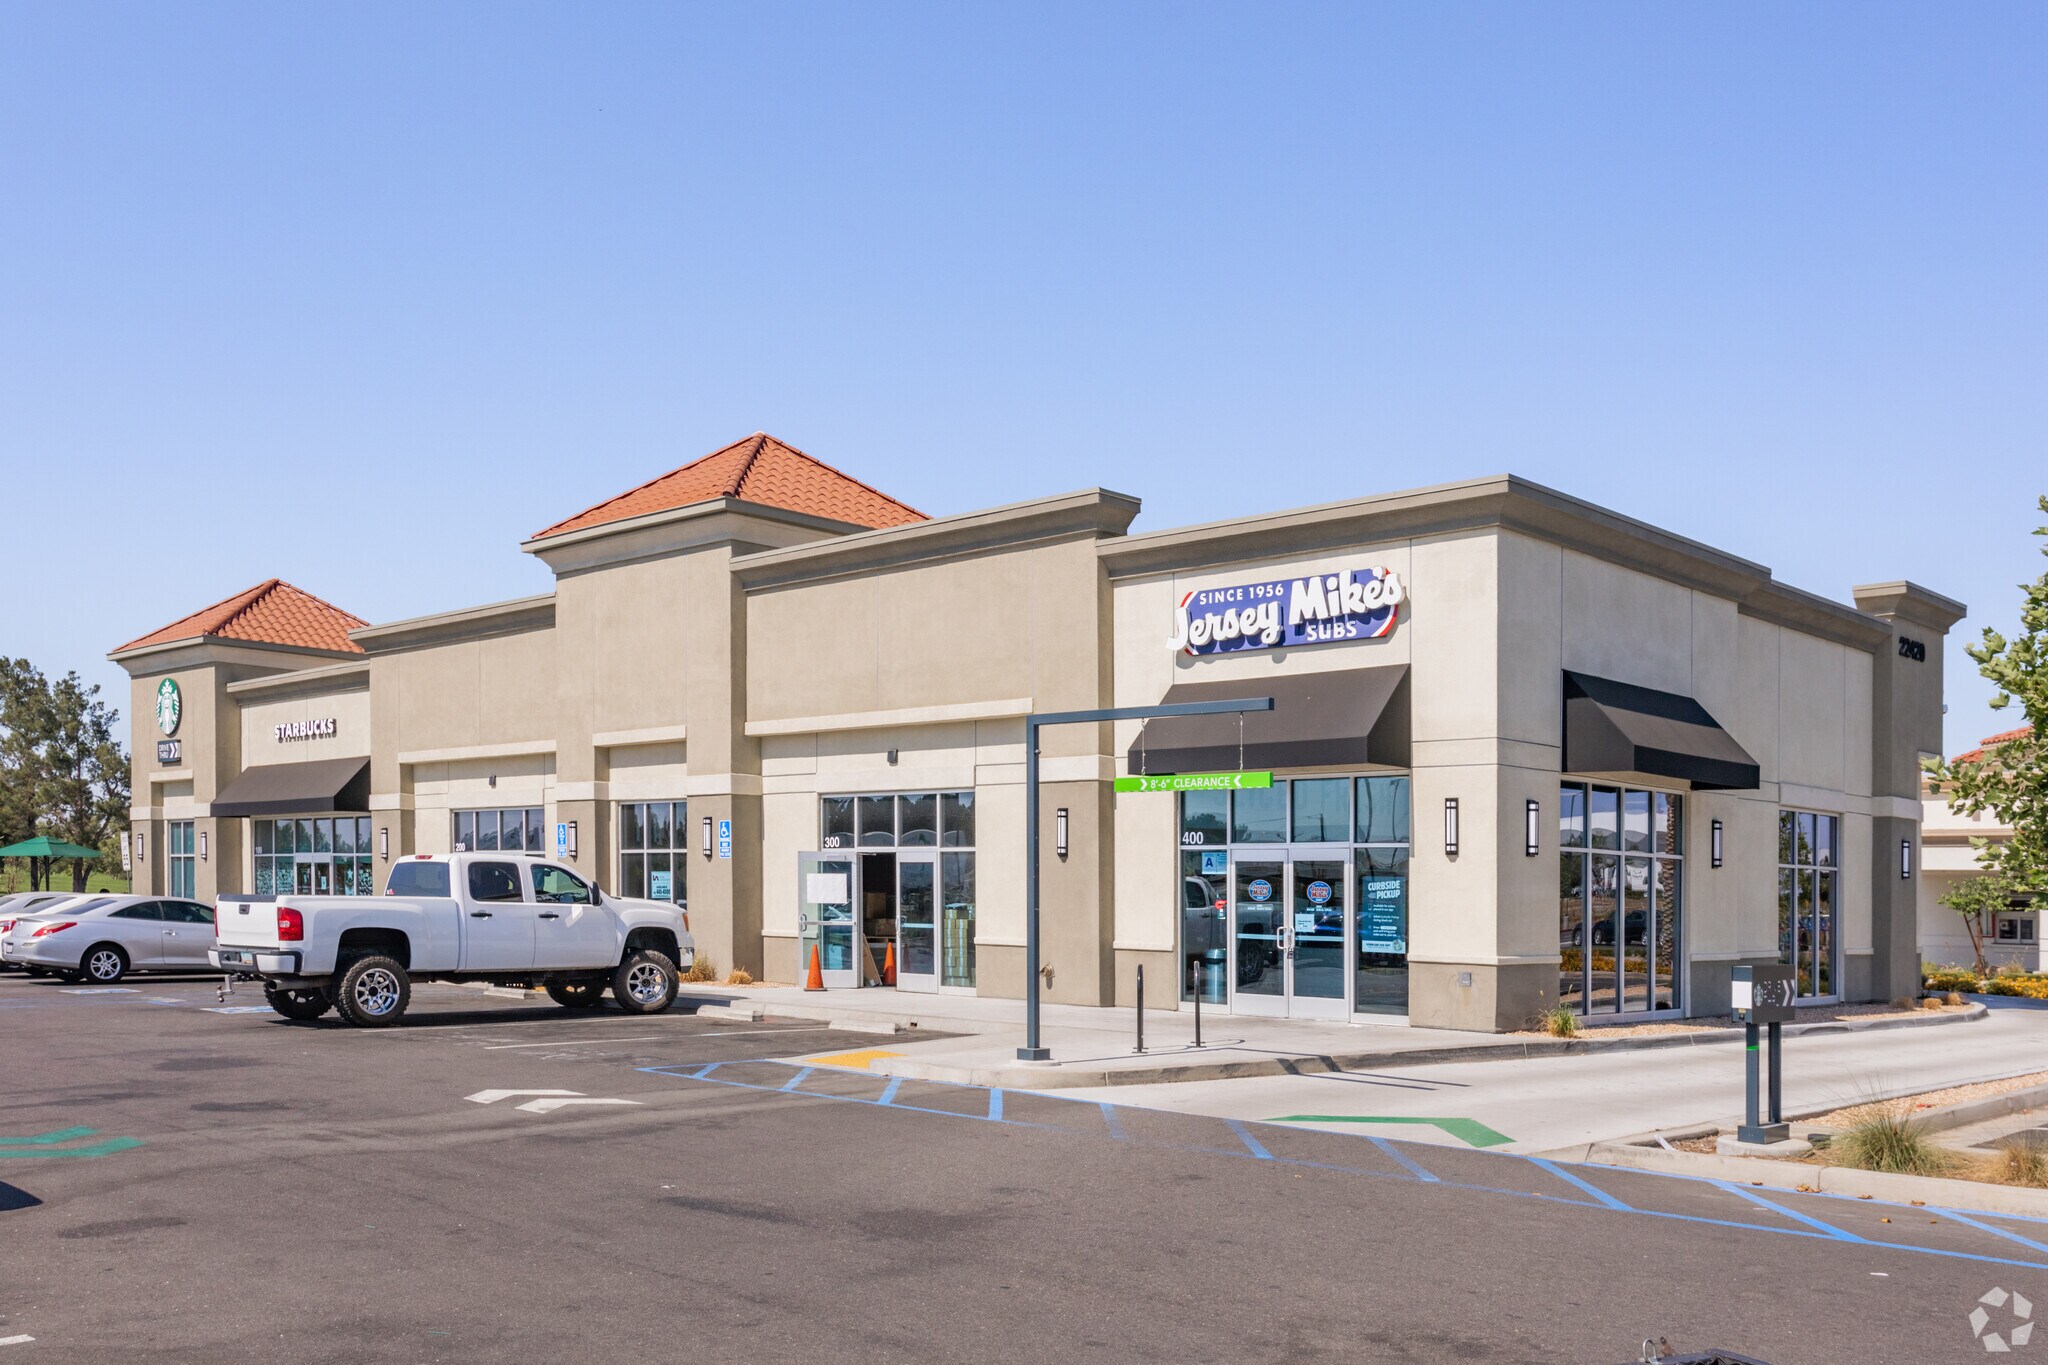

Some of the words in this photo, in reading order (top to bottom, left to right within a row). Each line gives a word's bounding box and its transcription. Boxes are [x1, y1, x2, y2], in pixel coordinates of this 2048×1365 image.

[1199, 588, 1243, 605] SINCE
[1249, 583, 1284, 600] 1956
[1164, 600, 1284, 650] Jersey
[1288, 565, 1405, 626] Mike's
[1306, 620, 1357, 641] SUBS
[275, 718, 334, 740] STARBUCKS
[1174, 776, 1231, 788] CLEARANCE
[824, 836, 840, 848] 300
[1182, 831, 1204, 845] 400
[455, 842, 466, 852] 200
[1205, 857, 1214, 868] A
[1367, 880, 1401, 891] CURBSIDE
[1376, 889, 1401, 900] PICKUP
